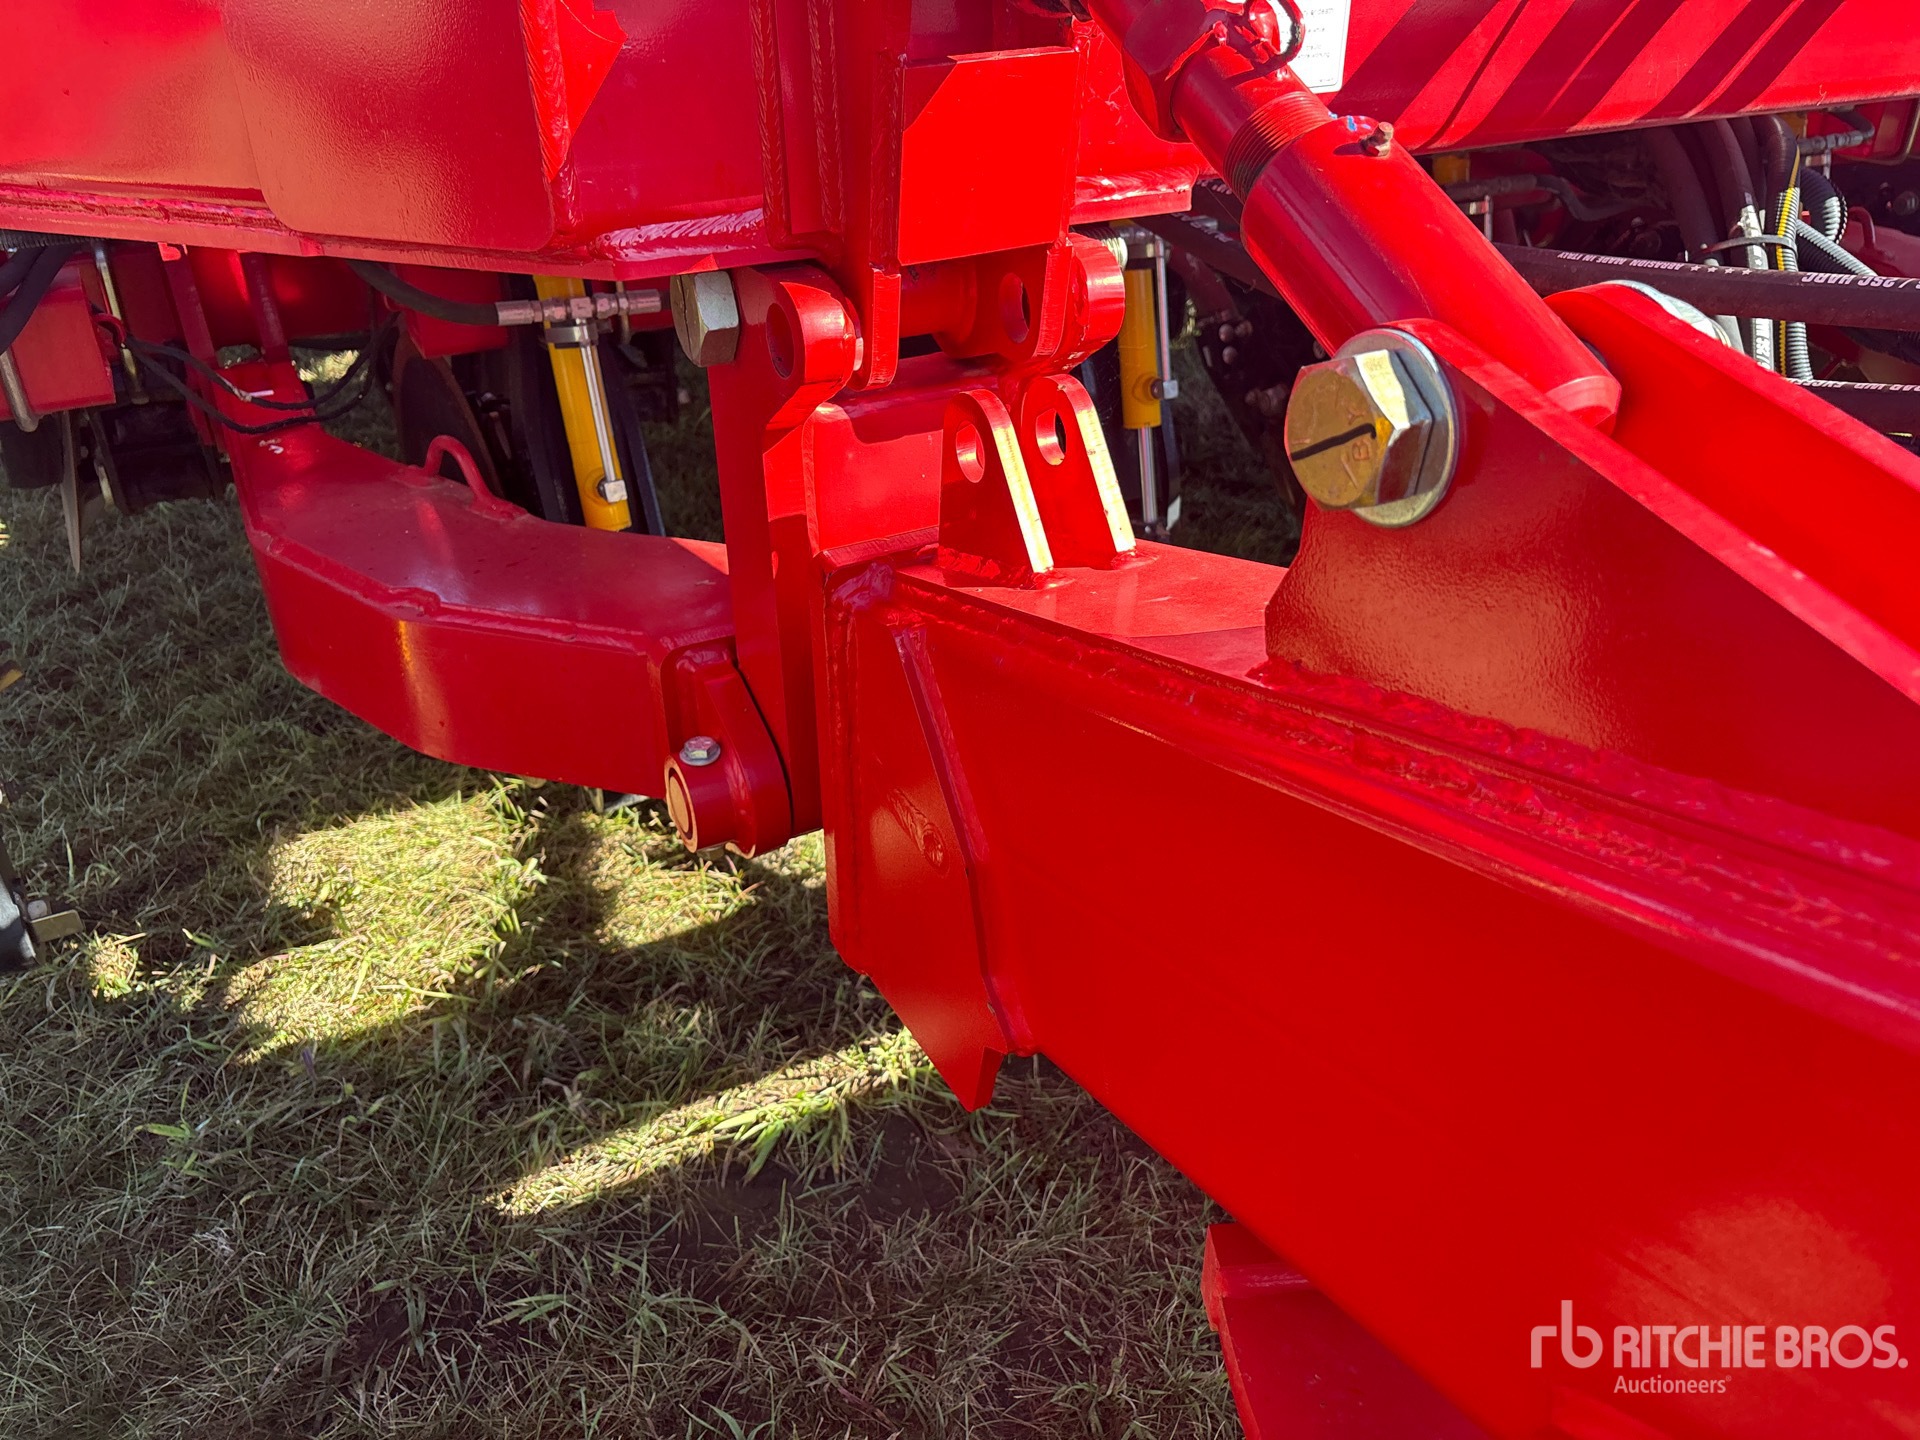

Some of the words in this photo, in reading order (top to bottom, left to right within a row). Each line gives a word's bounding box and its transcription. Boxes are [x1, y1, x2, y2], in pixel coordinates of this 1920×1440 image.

[1557, 251, 1583, 261] ITALY
[1582, 254, 1597, 262] IN
[1596, 256, 1627, 265] MADE
[1629, 259, 1685, 270] ABRASION
